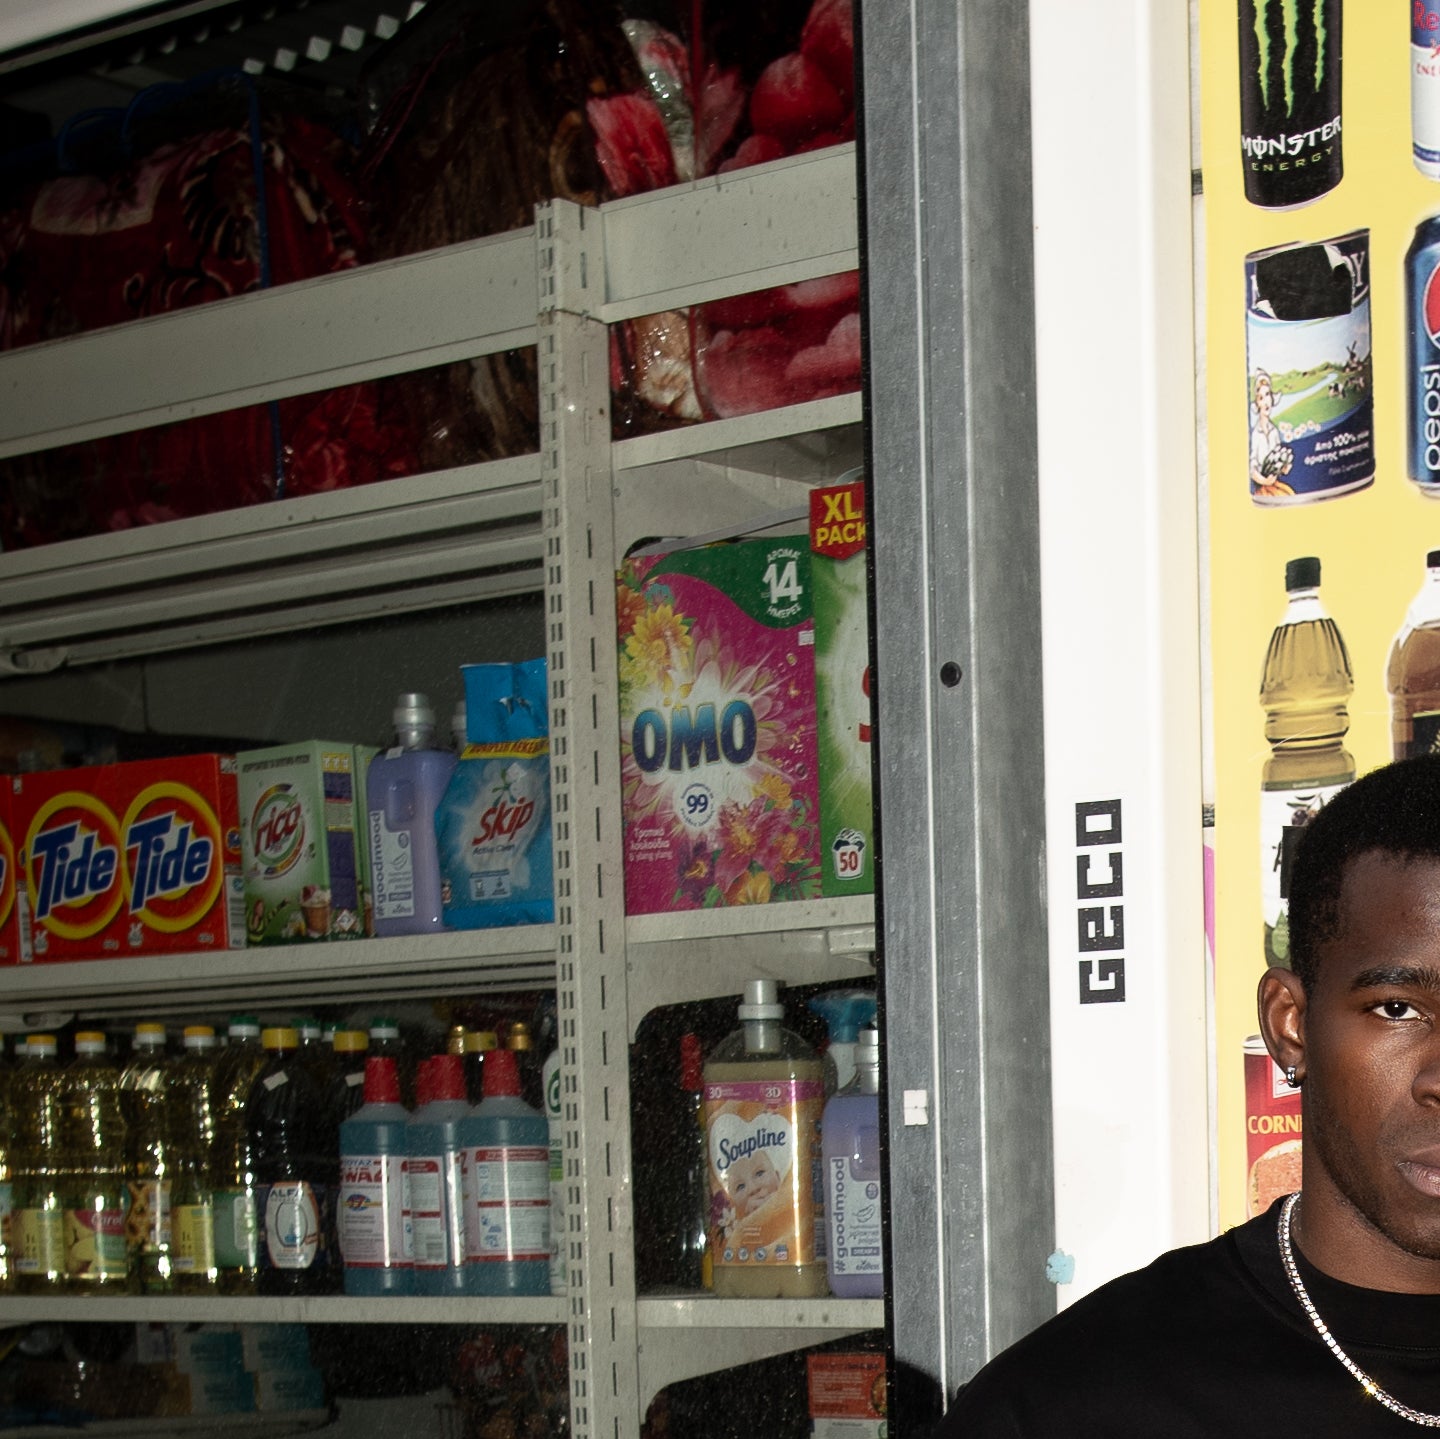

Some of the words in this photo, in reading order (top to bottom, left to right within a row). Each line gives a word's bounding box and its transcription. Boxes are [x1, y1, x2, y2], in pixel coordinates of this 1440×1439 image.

[1252, 147, 1335, 171] ENERGY
[822, 491, 862, 524] XL
[762, 561, 803, 604] 14
[632, 700, 757, 773] OMO
[686, 793, 709, 814] 99
[32, 820, 118, 922] Tide
[124, 811, 213, 915] Tide
[370, 812, 386, 916] #goodmood
[839, 851, 859, 872] 50
[1248, 1115, 1302, 1134] CORN
[716, 1128, 786, 1171] Soupline
[831, 1158, 848, 1272] #goodmood
